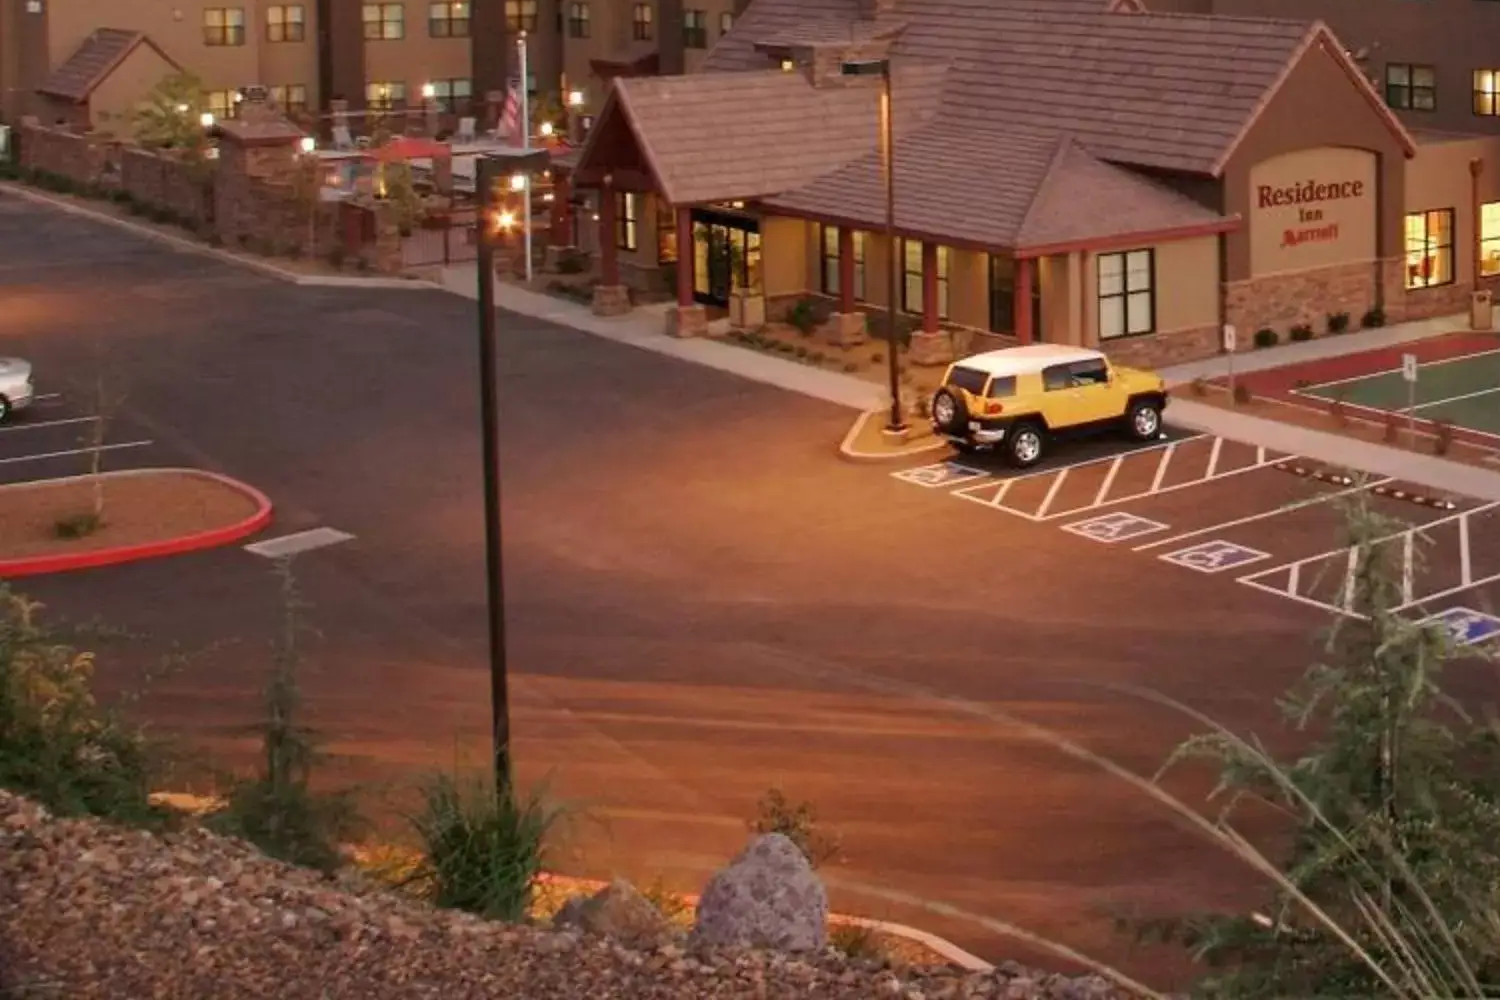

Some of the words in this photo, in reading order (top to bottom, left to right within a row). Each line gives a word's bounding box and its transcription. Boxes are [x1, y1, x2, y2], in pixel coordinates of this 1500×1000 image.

[1257, 180, 1364, 208] Residence
[1299, 208, 1323, 223] Inn
[1280, 223, 1339, 248] Marriott
